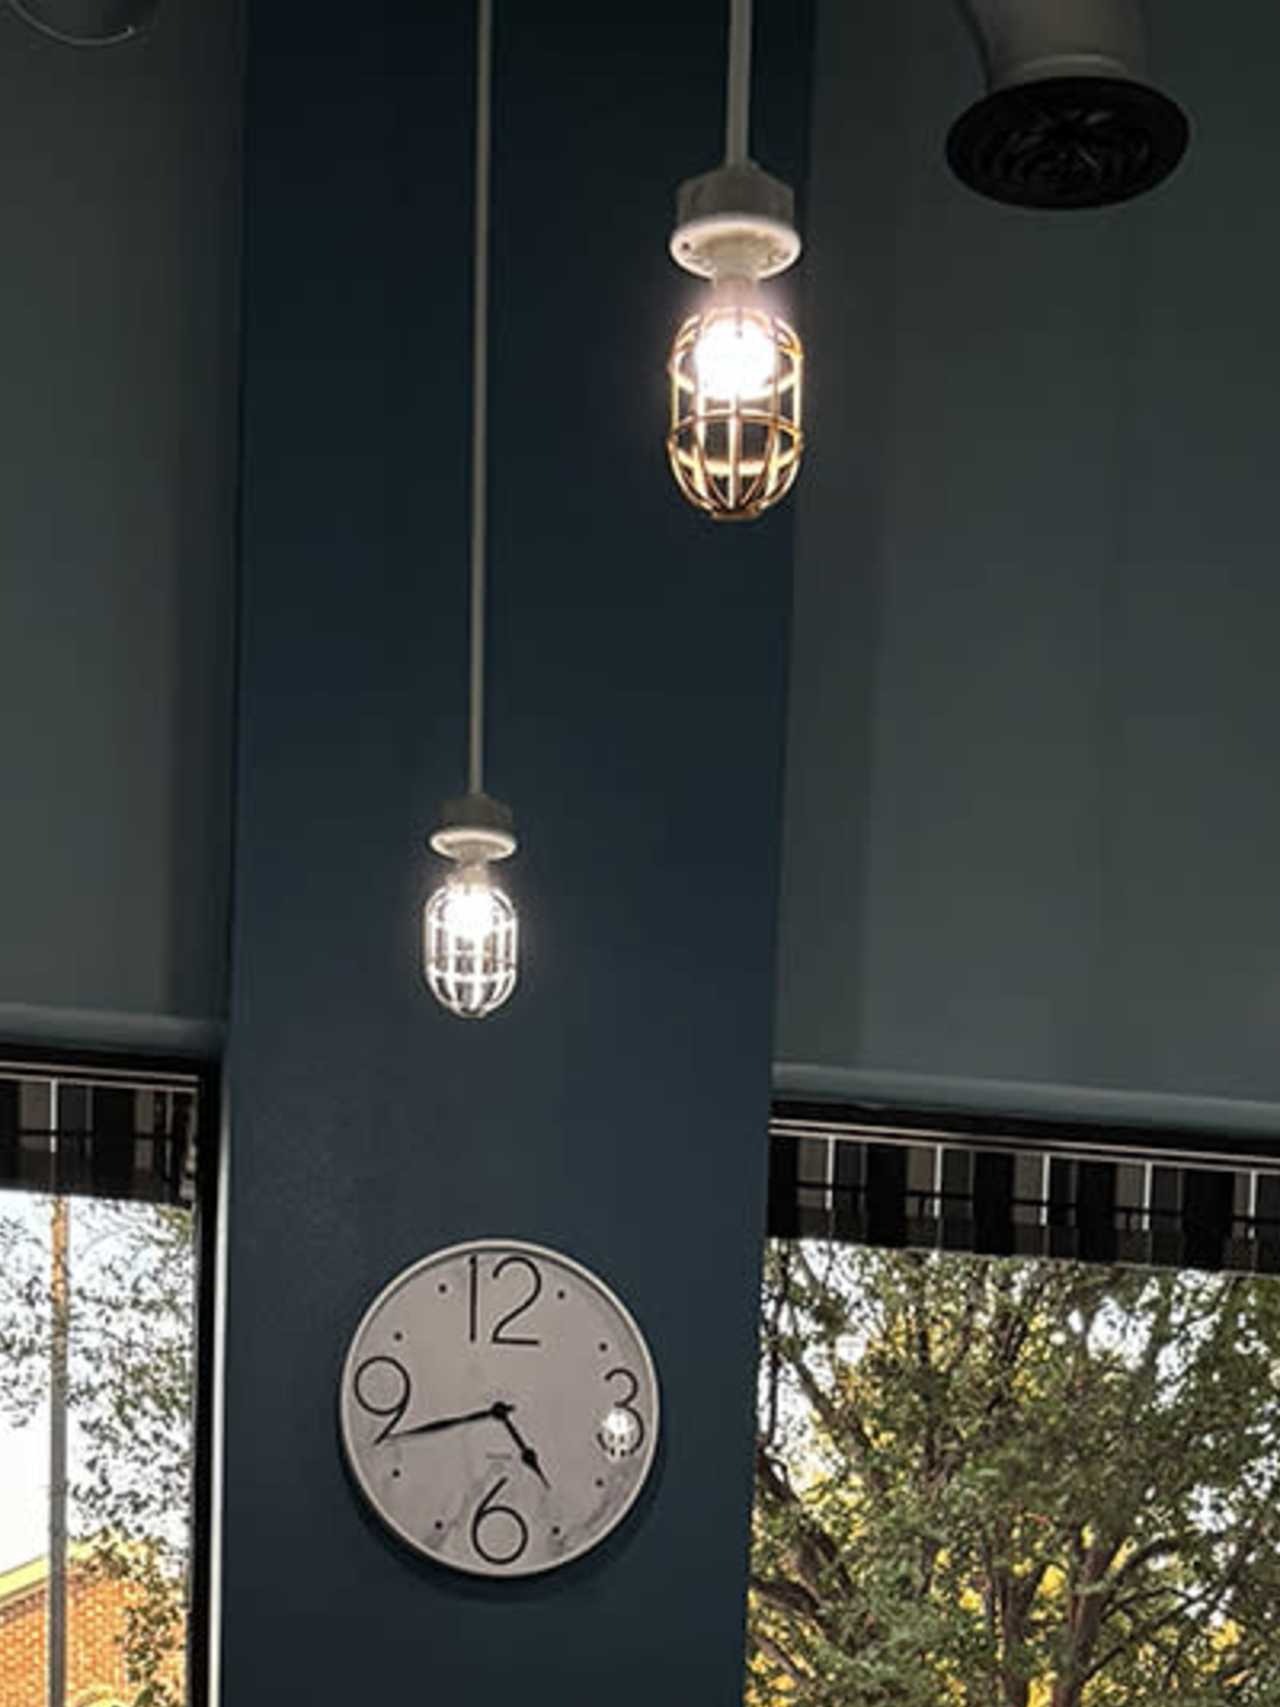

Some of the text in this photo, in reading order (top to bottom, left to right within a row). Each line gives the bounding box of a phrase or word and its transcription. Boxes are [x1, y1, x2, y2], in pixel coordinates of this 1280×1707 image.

[468, 1255, 543, 1345] 12
[353, 1355, 412, 1447] 9
[597, 1367, 646, 1458] 3
[471, 1476, 529, 1566] 6
